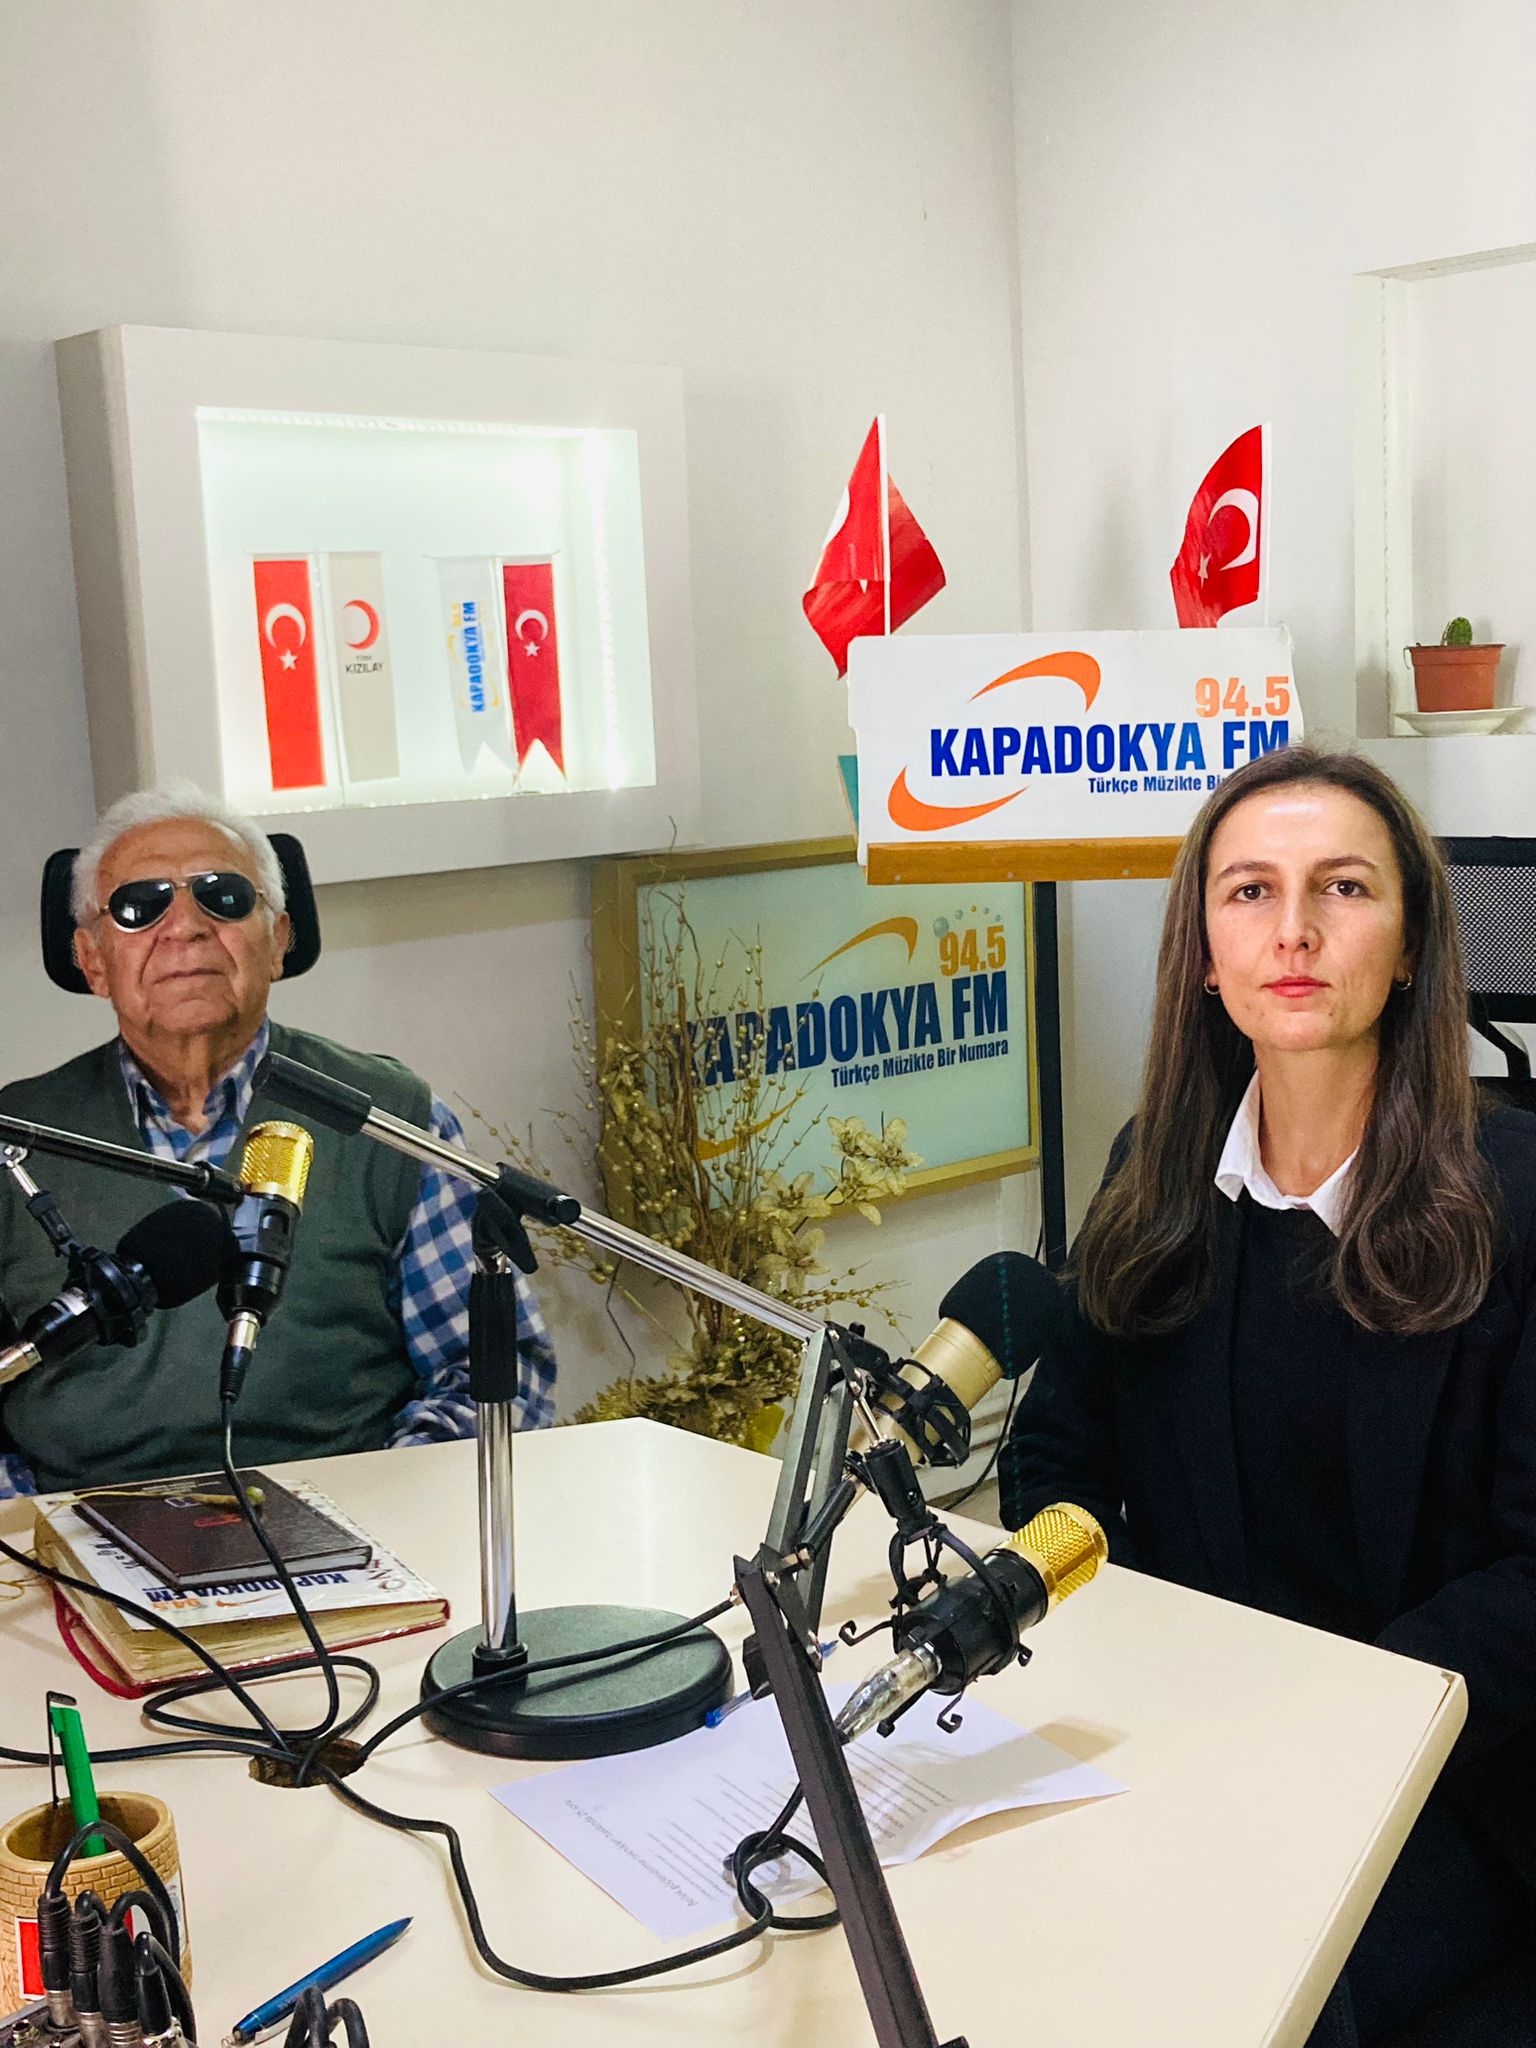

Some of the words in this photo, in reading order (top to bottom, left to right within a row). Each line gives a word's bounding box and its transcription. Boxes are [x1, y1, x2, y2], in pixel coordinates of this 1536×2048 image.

[345, 662, 383, 673] KIZILAY
[1195, 676, 1290, 718] 94.5
[930, 721, 1206, 777] KAPADOKYA
[1223, 720, 1289, 770] FM
[1088, 776, 1137, 794] Türkçe
[1144, 775, 1202, 792] Müzikte
[938, 925, 1006, 977] 94.5
[951, 970, 1008, 1041] FM
[831, 1063, 880, 1088] Türkçe
[883, 1052, 934, 1078] Müzikte
[937, 1046, 957, 1068] Bir
[959, 1039, 1009, 1063] Numara
